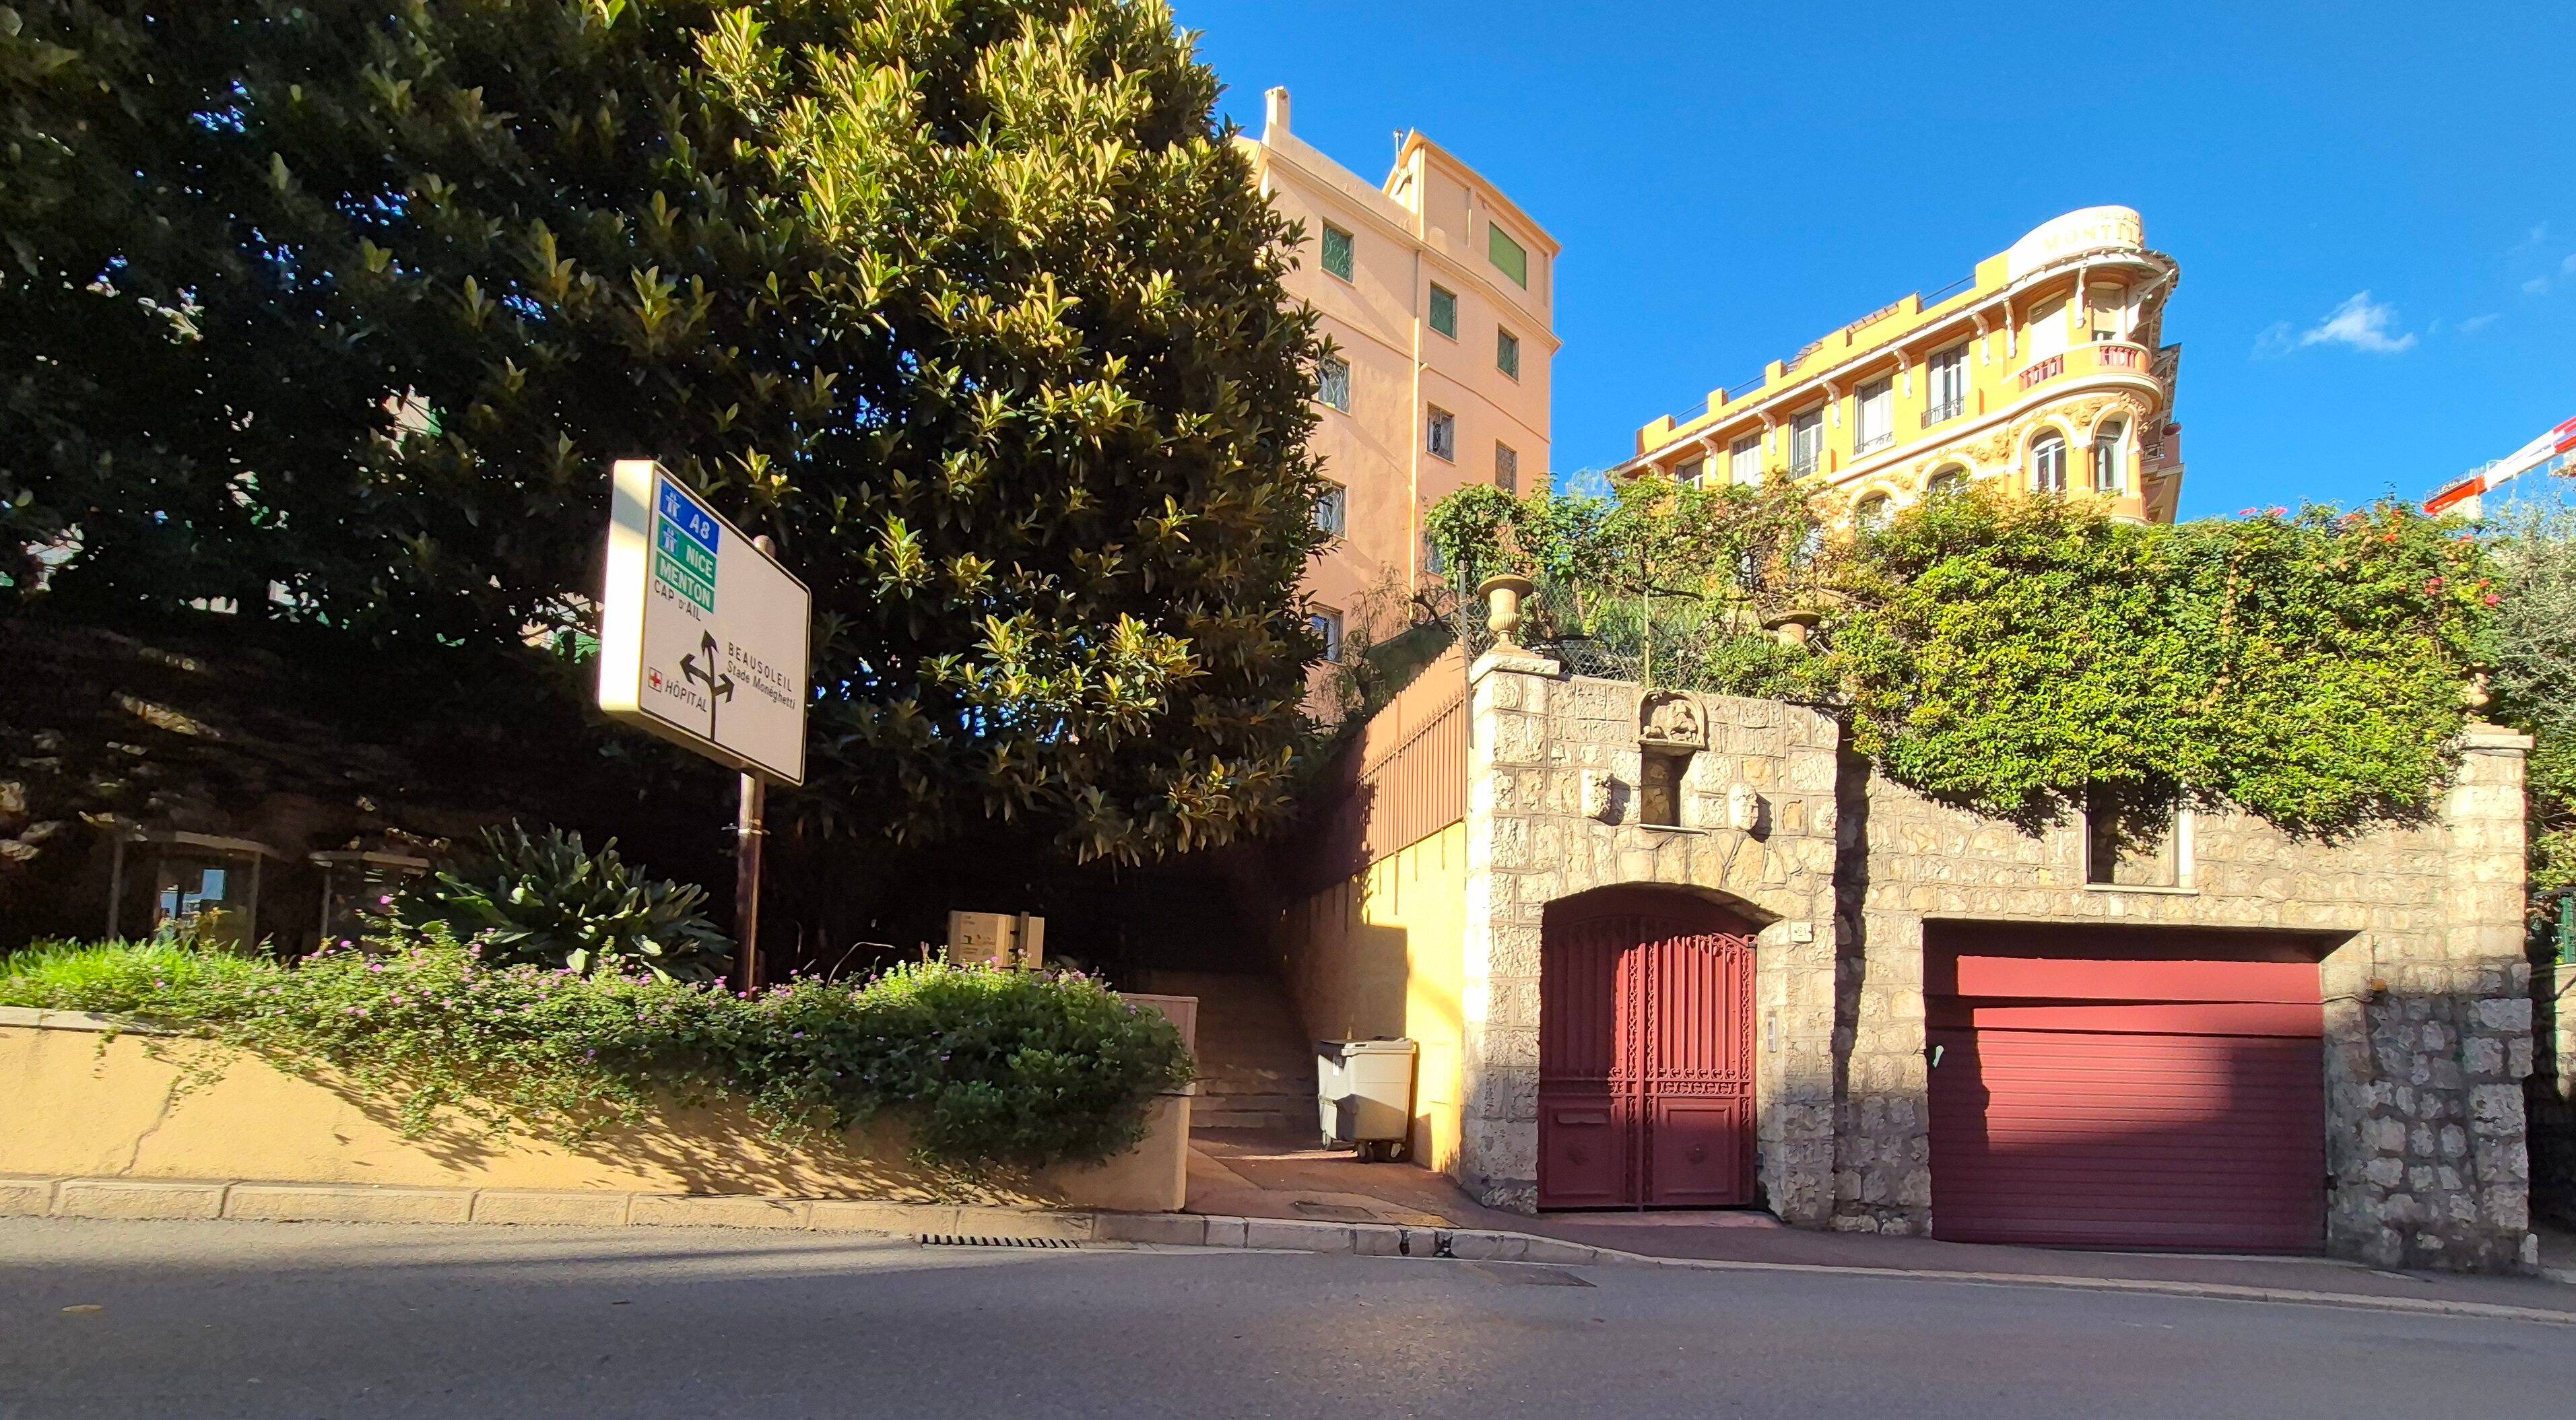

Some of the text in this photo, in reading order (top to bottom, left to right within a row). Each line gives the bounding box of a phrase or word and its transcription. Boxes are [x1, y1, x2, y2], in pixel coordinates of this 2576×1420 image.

[689, 514, 711, 539] A8
[686, 544, 714, 579] NICE
[655, 579, 674, 601] CAP
[660, 557, 711, 609] MENTON
[729, 642, 792, 692] BEAUSOLEIL
[665, 679, 707, 712] HÔPITAL
[727, 660, 796, 710] Stade Monéghetti
